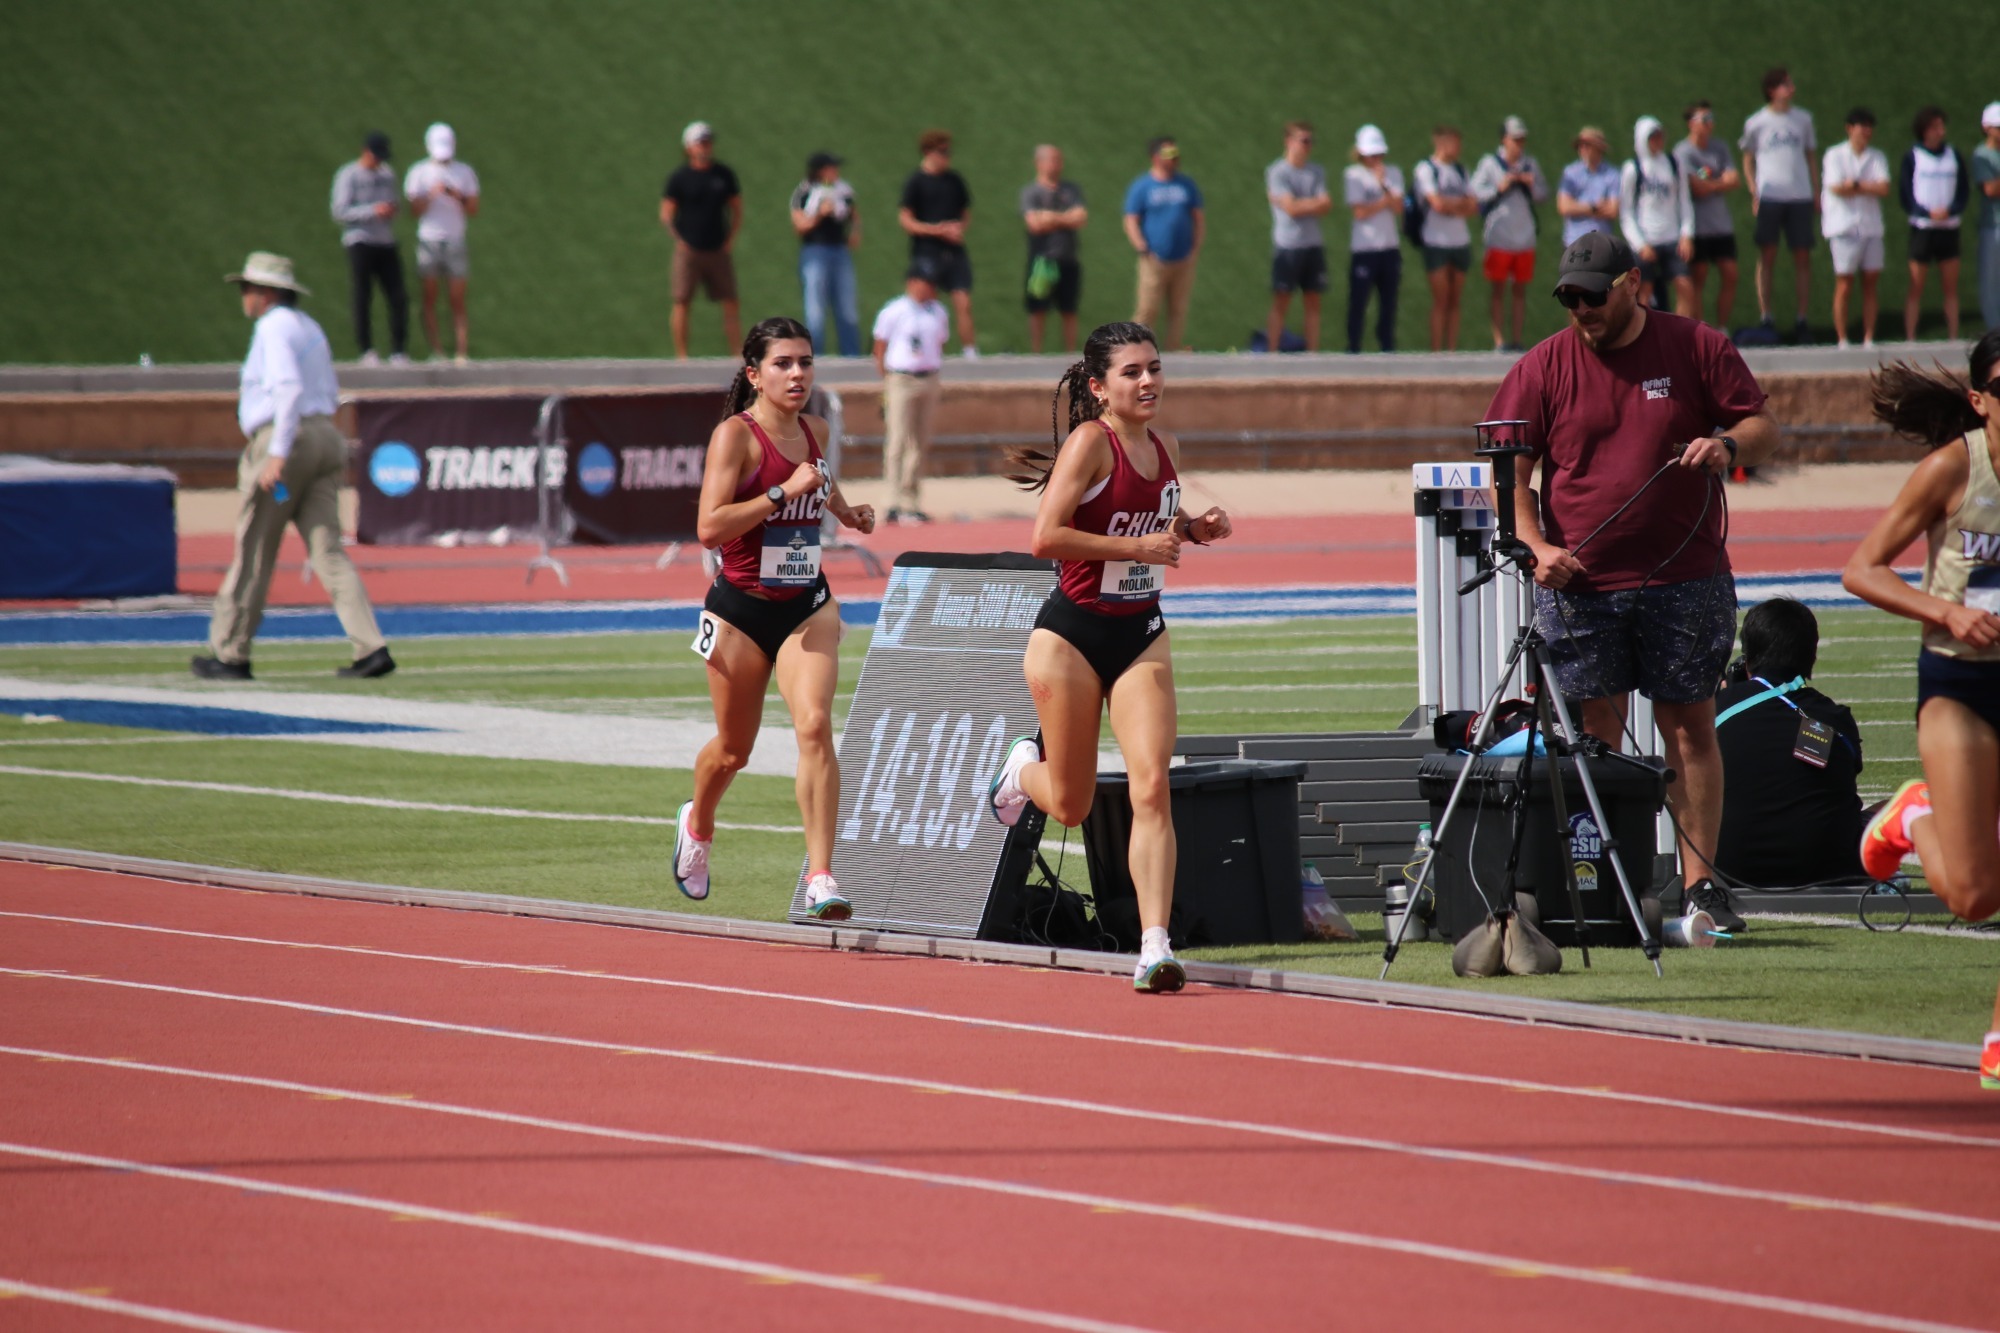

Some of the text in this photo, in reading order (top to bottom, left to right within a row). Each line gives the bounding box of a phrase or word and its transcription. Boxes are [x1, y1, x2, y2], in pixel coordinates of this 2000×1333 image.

[1647, 388, 1669, 400] DISCS
[425, 446, 539, 490] TRACK
[621, 446, 705, 490] TRACK
[786, 552, 808, 562] DELLA
[776, 563, 815, 576] MOLINA
[1128, 564, 1150, 576] IRESH
[1118, 577, 1154, 592] MOLINA
[700, 618, 713, 654] 8
[841, 708, 1006, 851] 14:19.9
[1570, 837, 1601, 853] CSU
